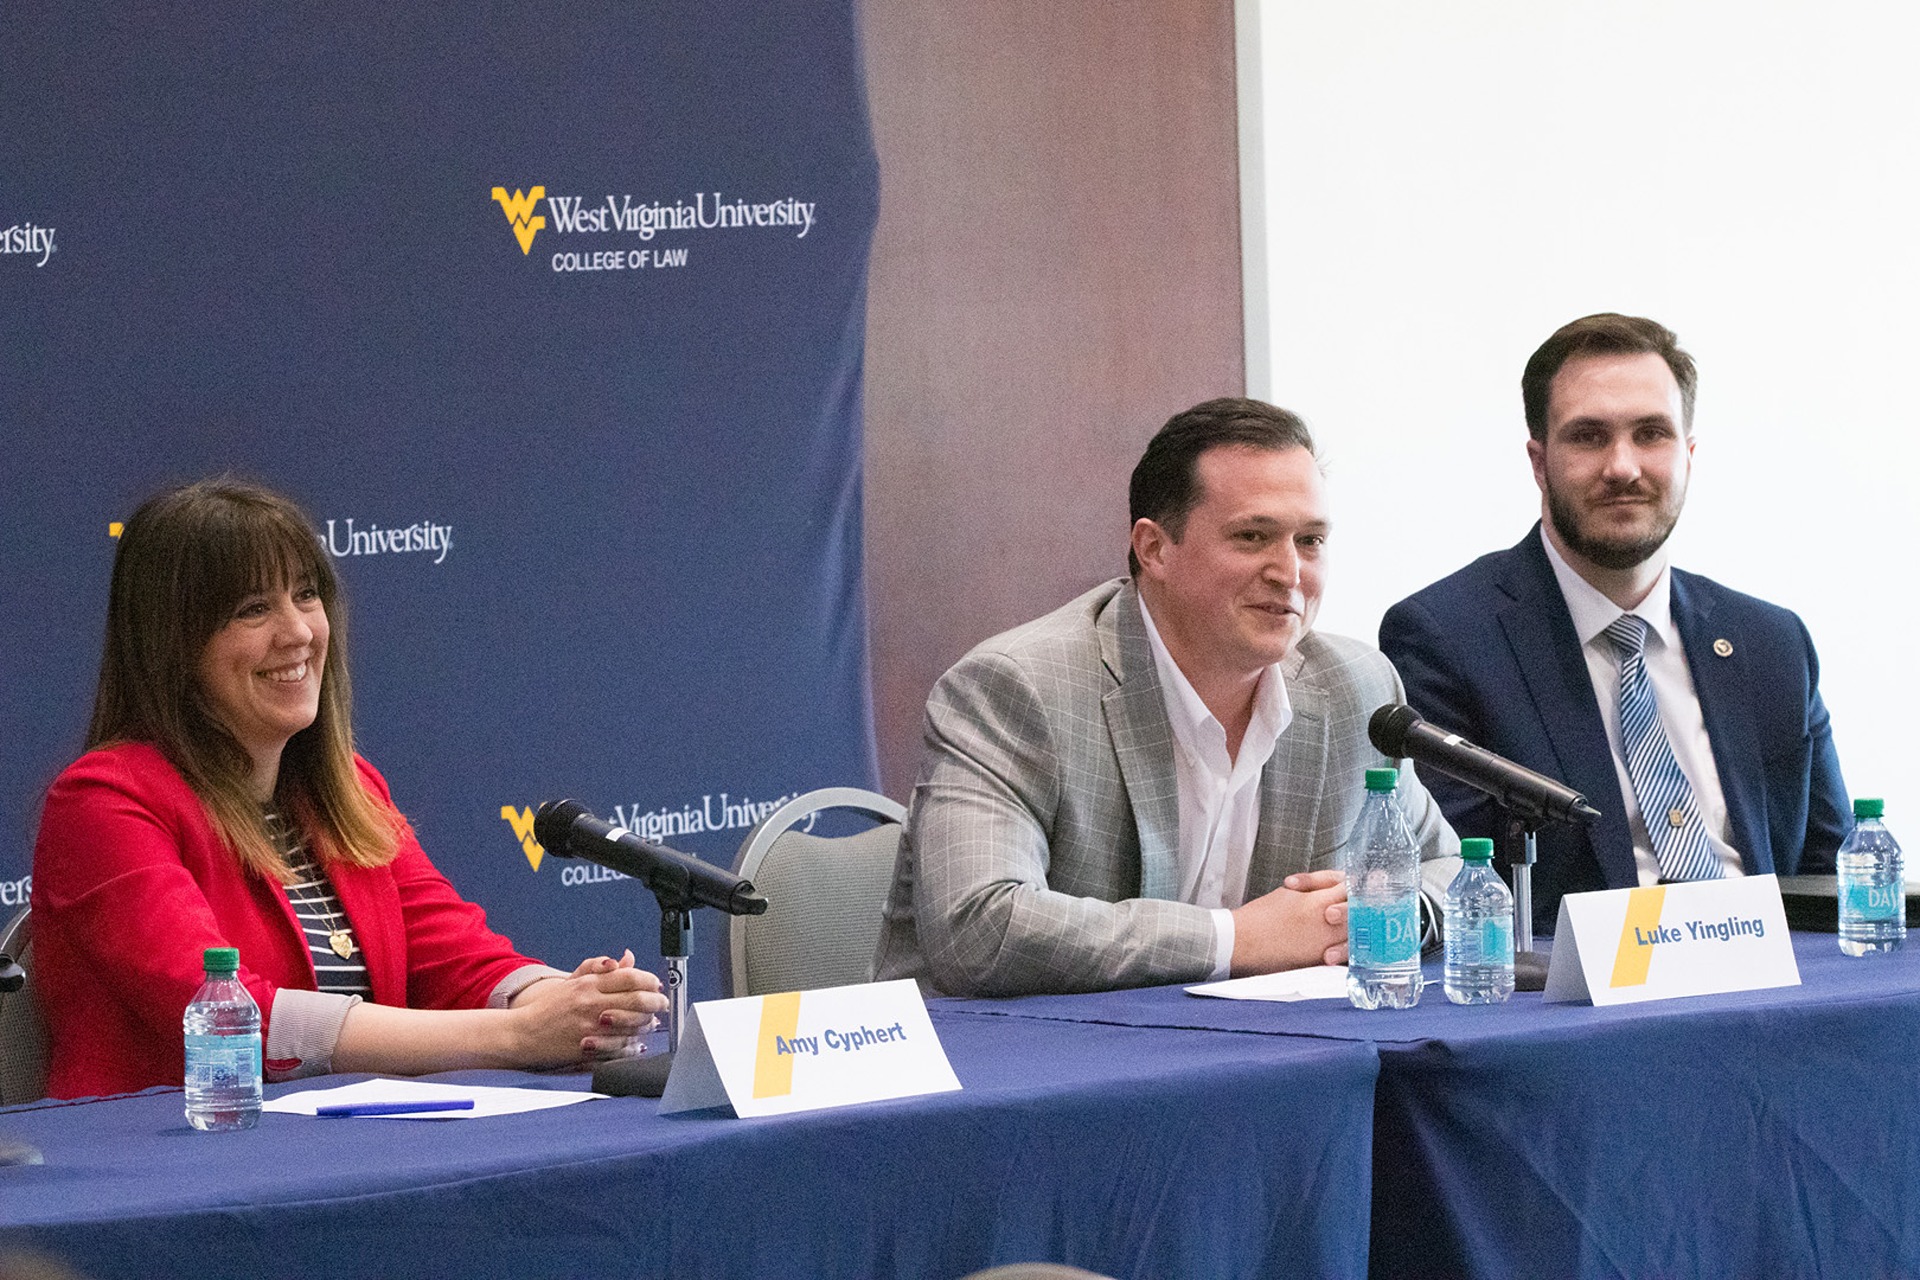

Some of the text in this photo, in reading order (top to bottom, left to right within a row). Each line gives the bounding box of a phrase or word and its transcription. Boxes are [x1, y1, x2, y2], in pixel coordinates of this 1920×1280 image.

[696, 192, 815, 238] University
[0, 222, 56, 268] rsity
[552, 248, 688, 272] COLLEGE OF LAW
[326, 518, 453, 564] University
[561, 865, 633, 887] COLLE
[1634, 916, 1765, 946] Luke Yingling
[775, 1022, 907, 1056] Amy Cyphert
